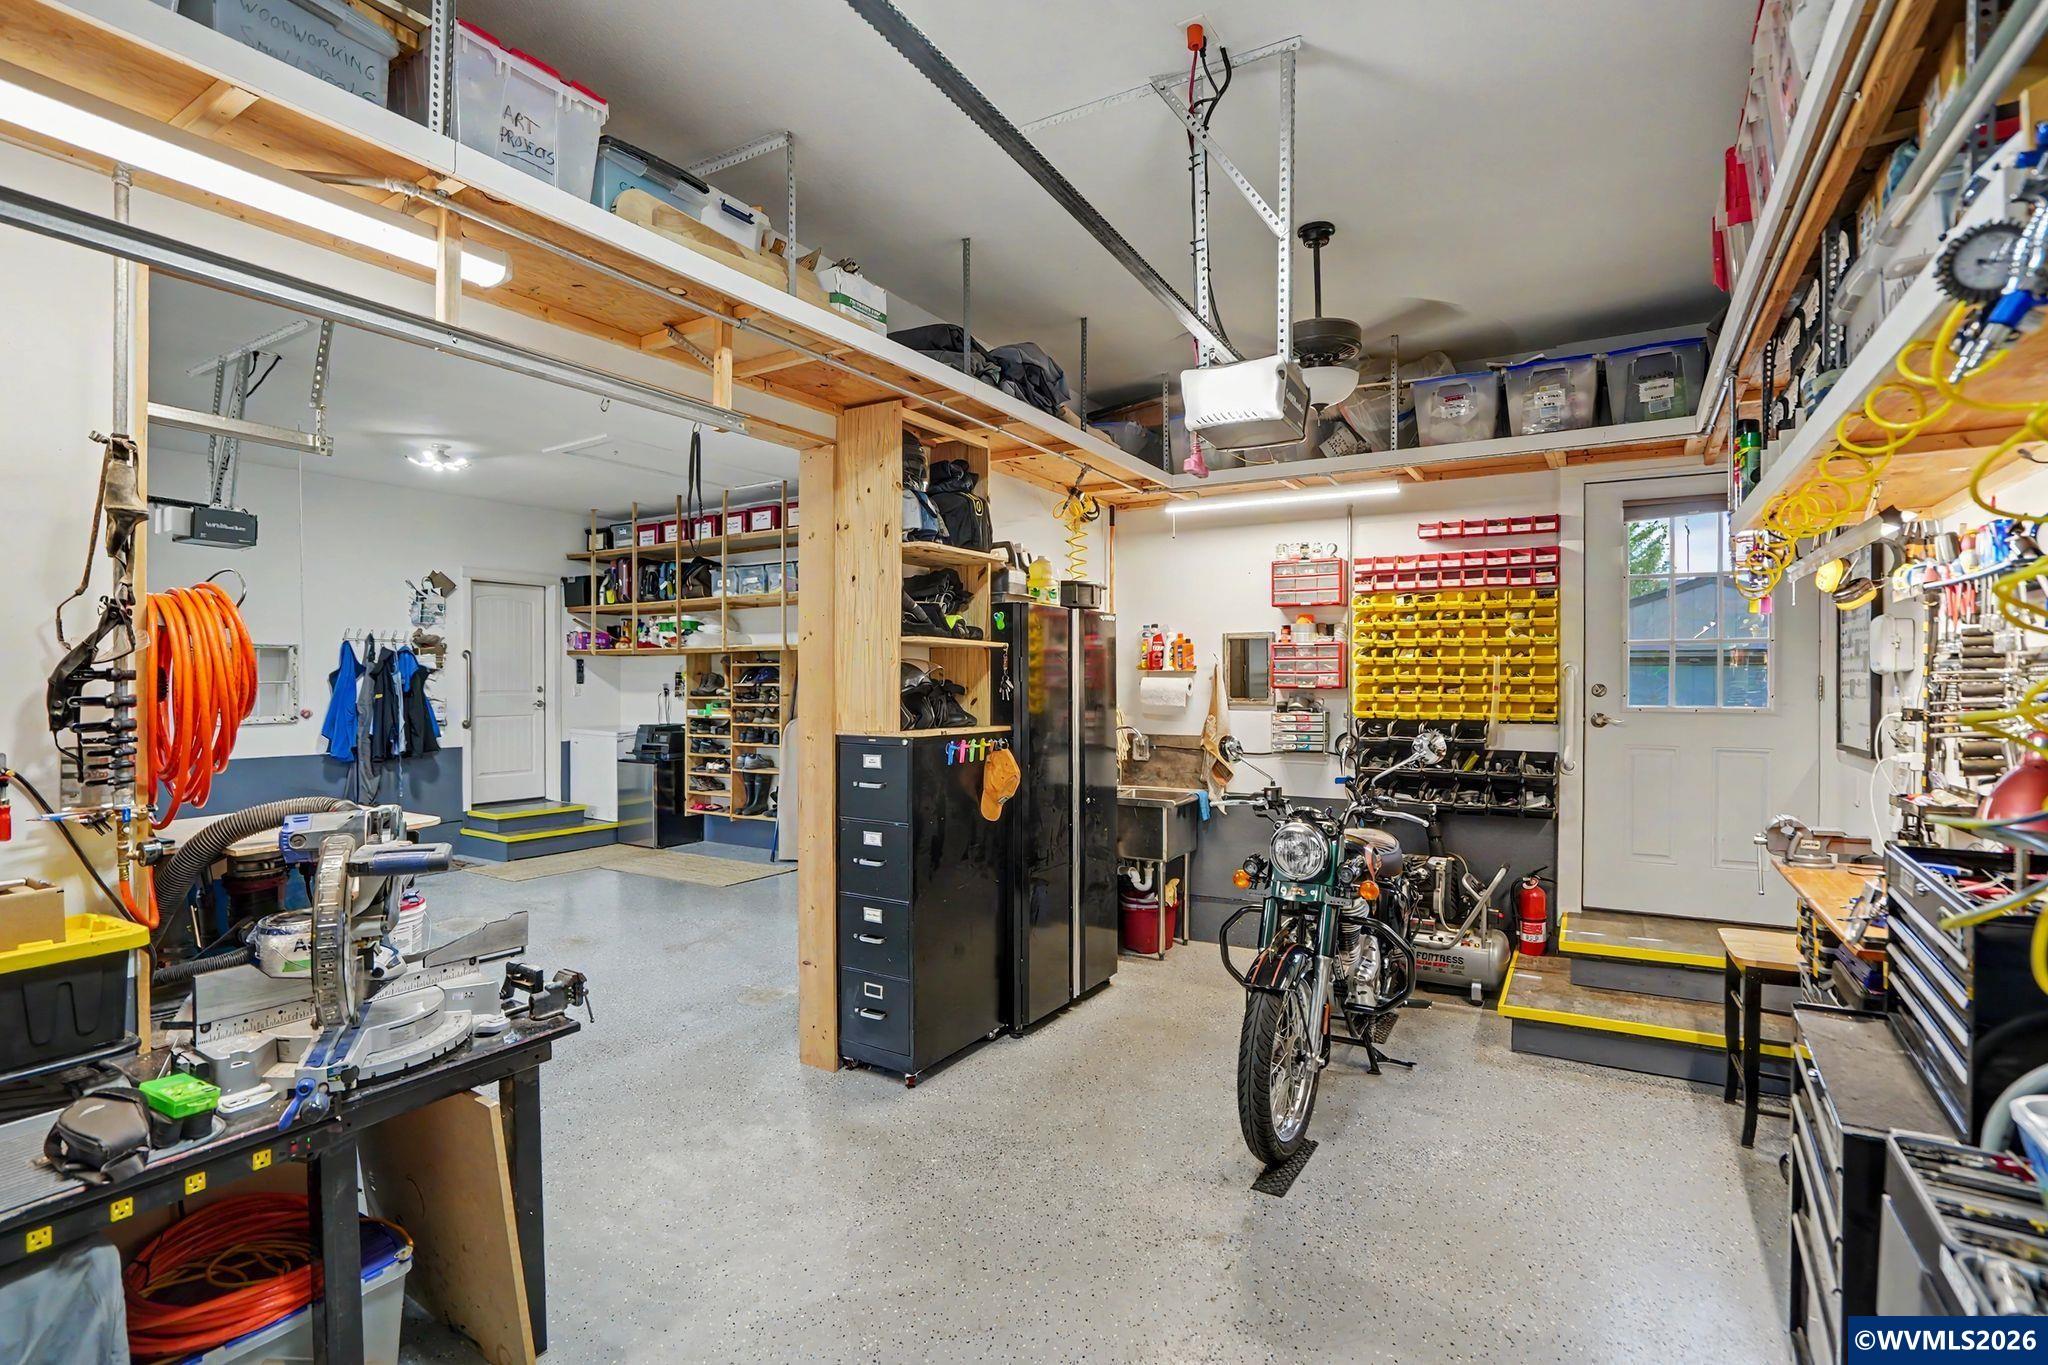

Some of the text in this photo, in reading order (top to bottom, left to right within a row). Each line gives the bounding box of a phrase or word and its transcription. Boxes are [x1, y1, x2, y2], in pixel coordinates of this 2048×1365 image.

[240, 0, 375, 81] WOODWORKING
[503, 105, 541, 134] ART
[500, 126, 555, 166] PROJECTS
[1416, 951, 1464, 965] FORTRESS
